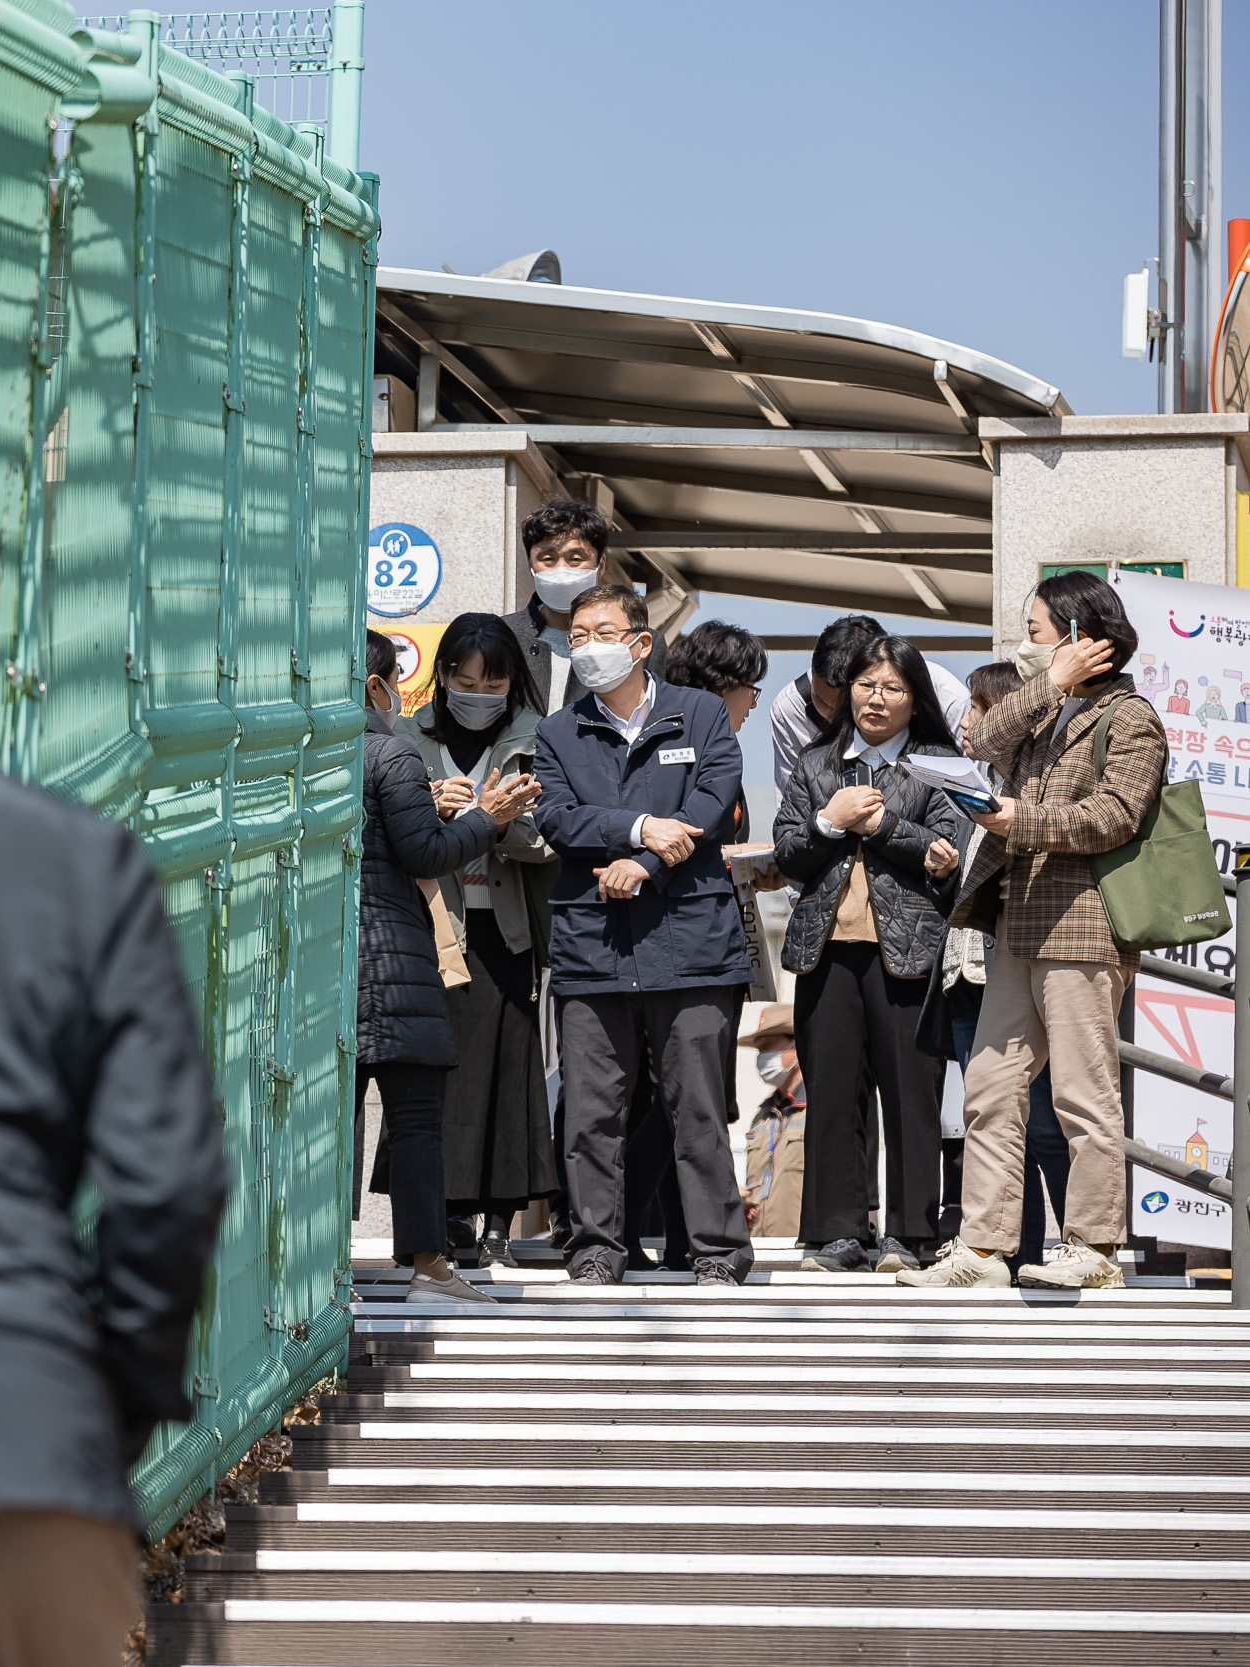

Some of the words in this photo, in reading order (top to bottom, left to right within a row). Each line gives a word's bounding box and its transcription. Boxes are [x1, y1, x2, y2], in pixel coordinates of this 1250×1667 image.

[375, 560, 417, 587] 82
[1210, 626, 1250, 647] 행복광
[1165, 727, 1207, 753] 현장
[1184, 759, 1226, 785] 소통
[1175, 1199, 1227, 1218] 광진구
